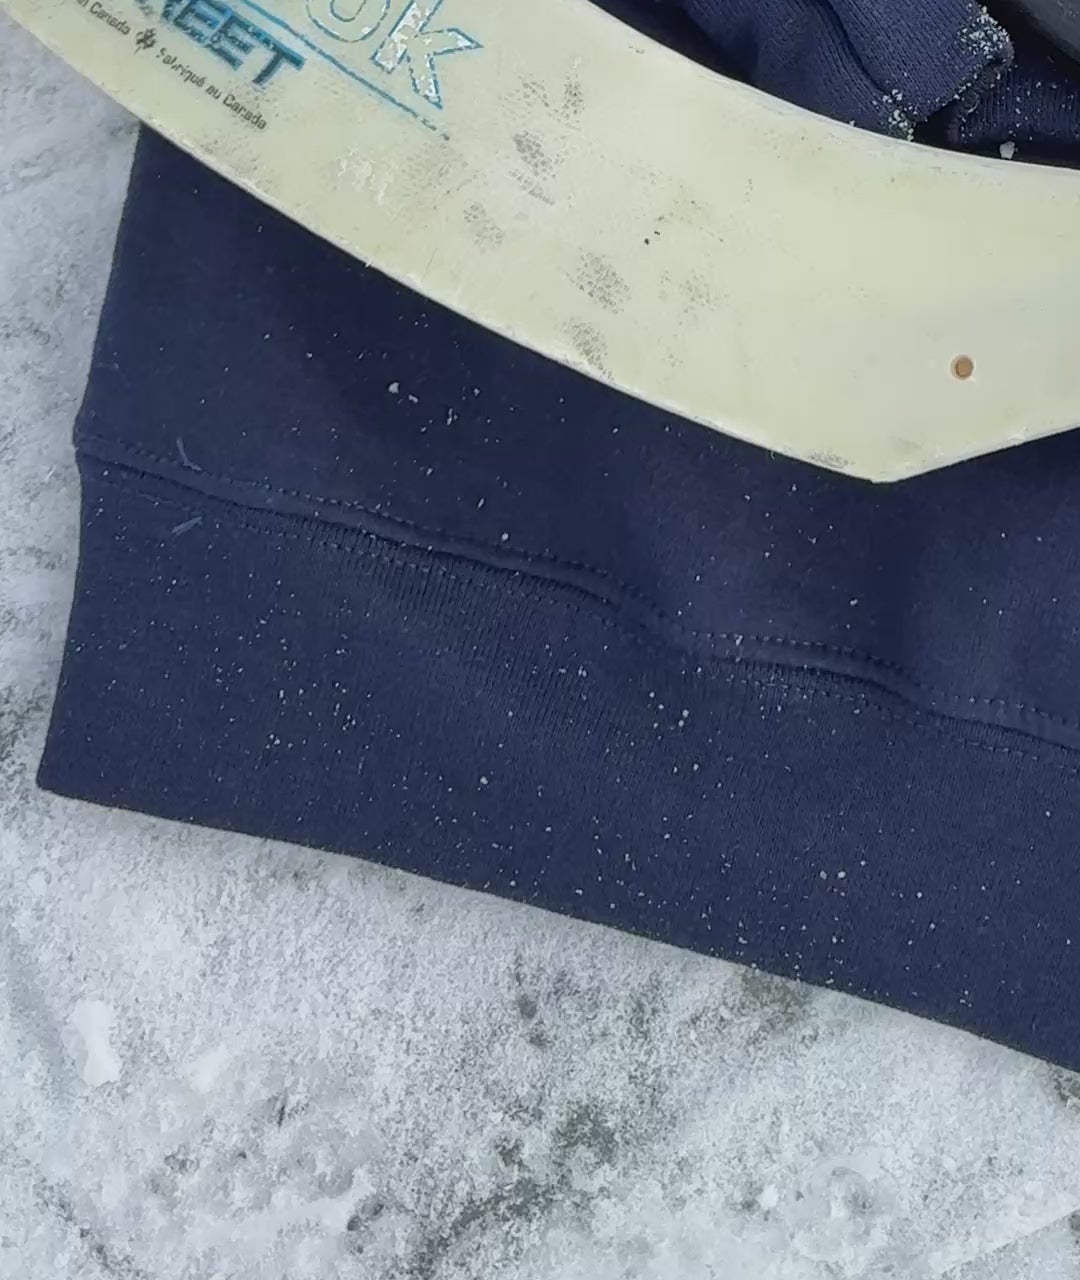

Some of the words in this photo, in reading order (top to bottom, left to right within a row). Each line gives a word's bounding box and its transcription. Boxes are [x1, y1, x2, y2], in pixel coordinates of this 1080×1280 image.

[90, 1, 131, 35] Canada
[206, 85, 222, 100] au
[223, 93, 267, 130] Canada
